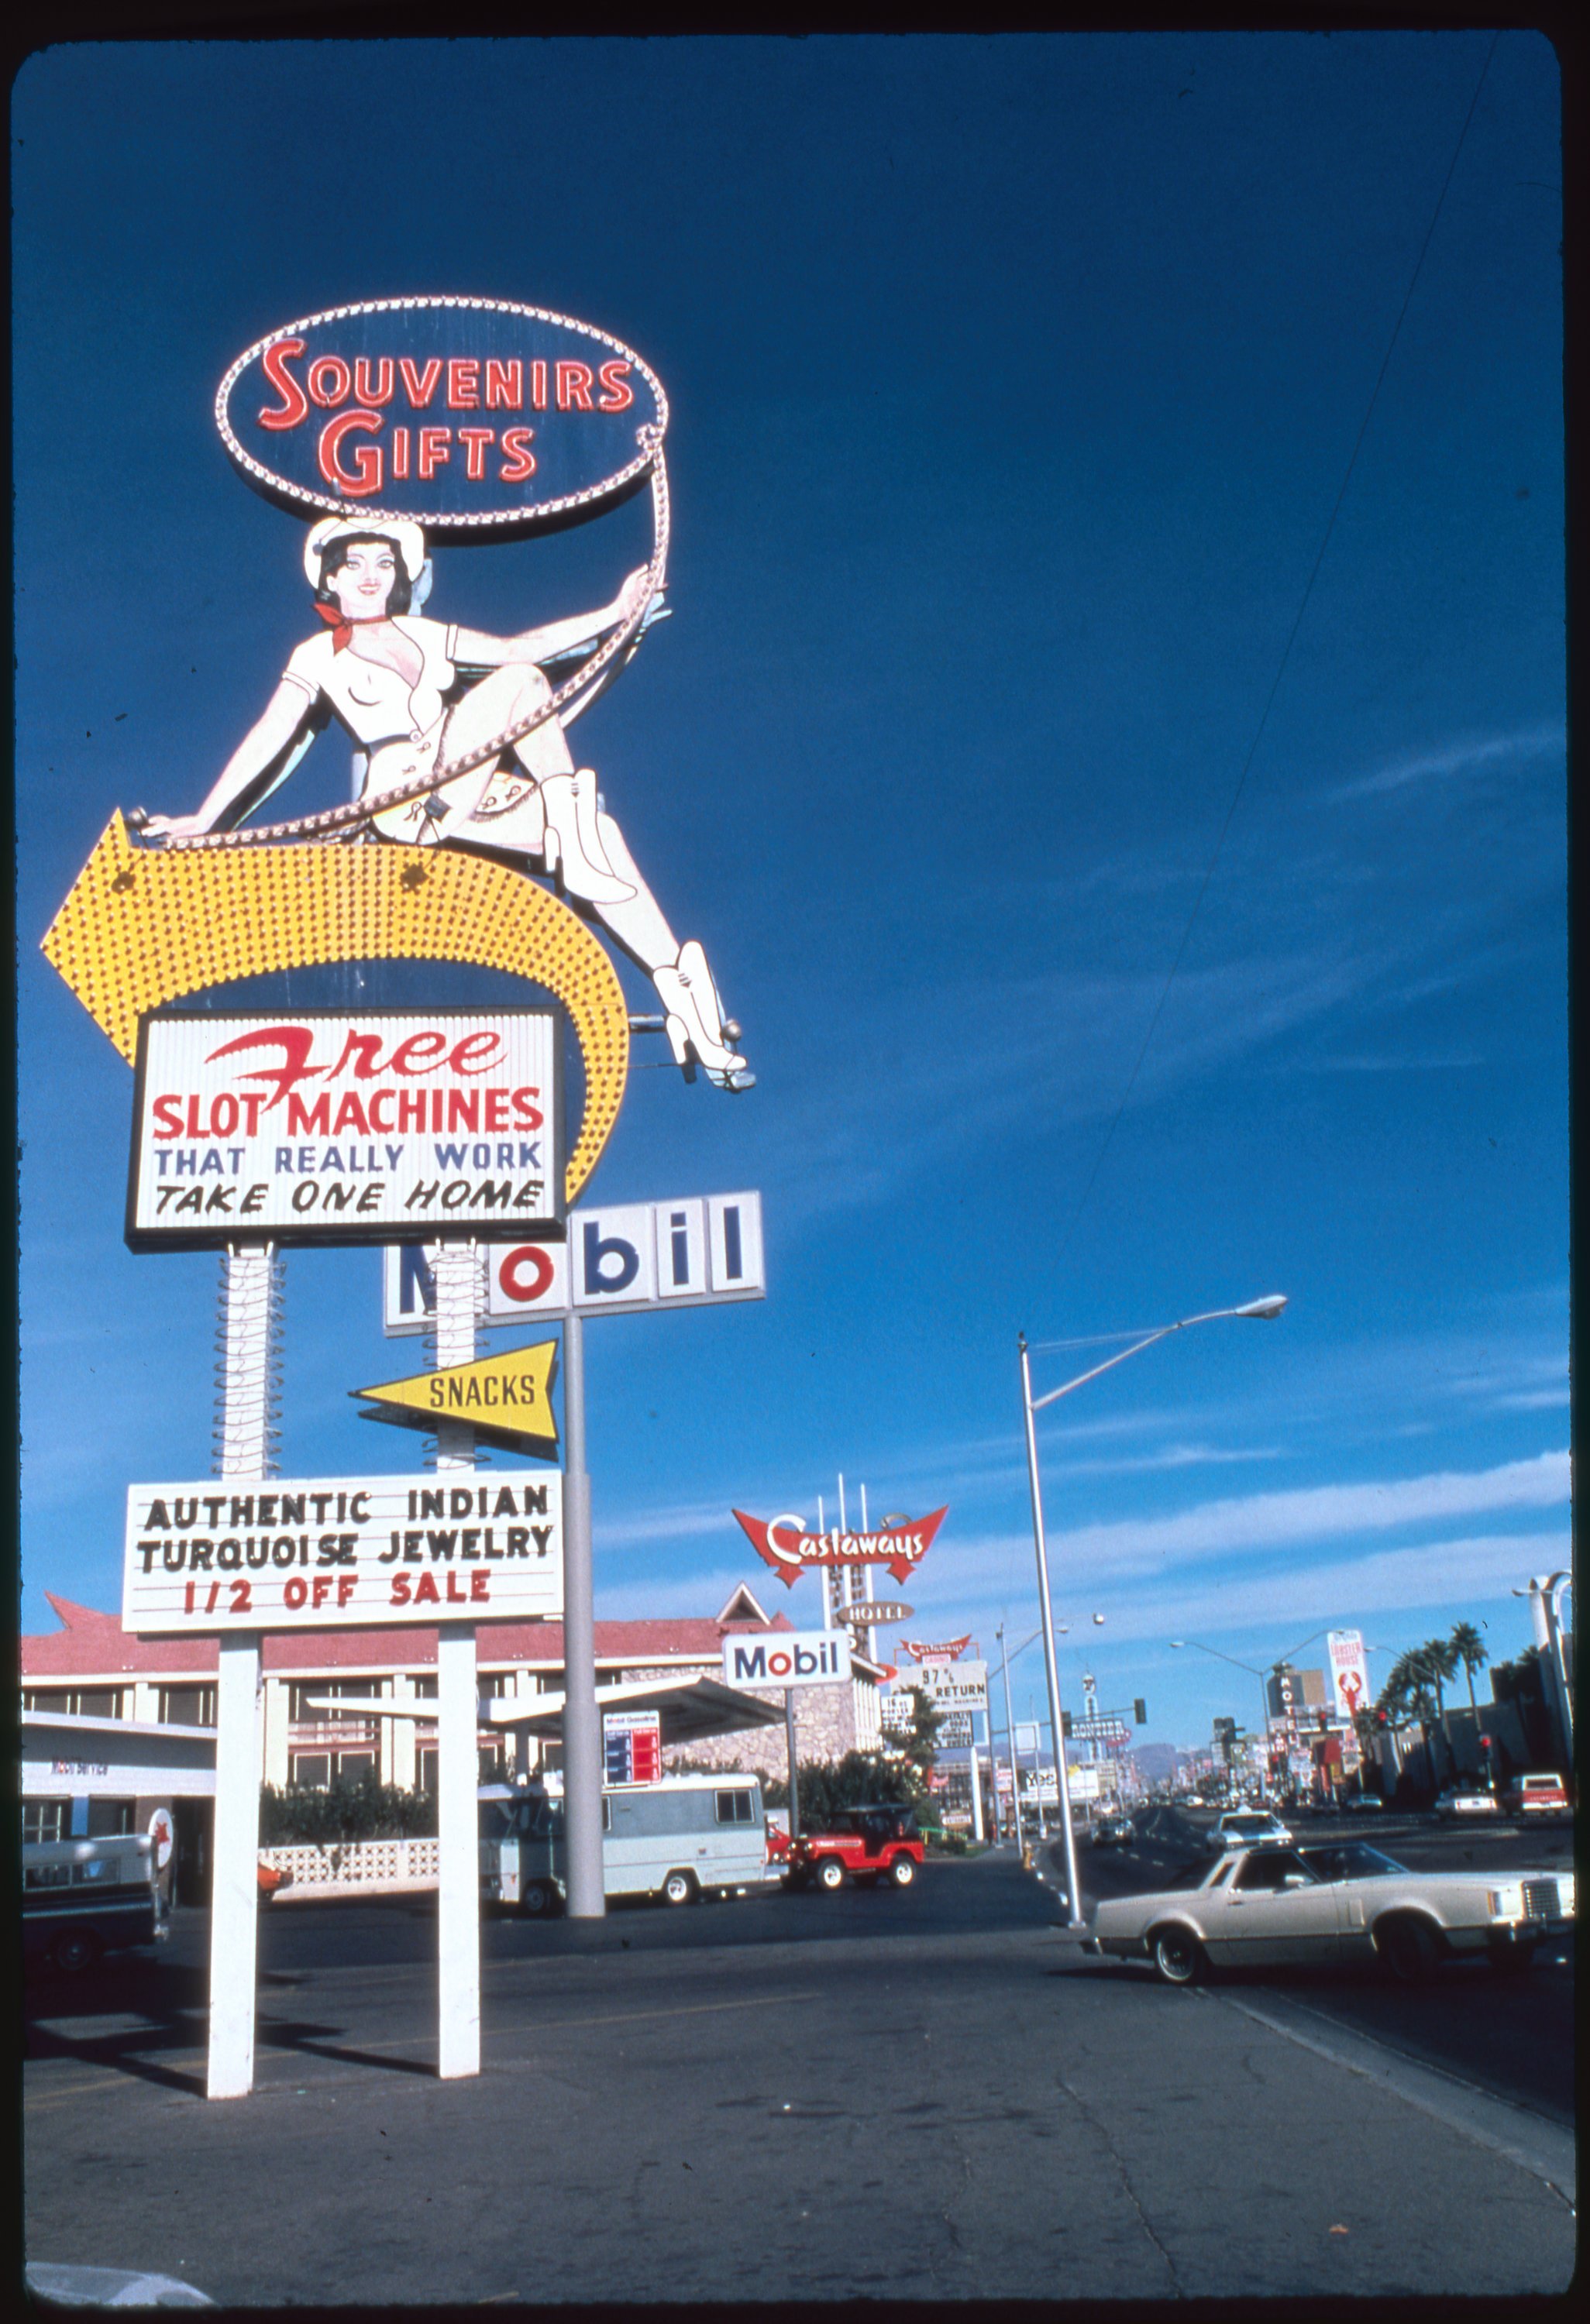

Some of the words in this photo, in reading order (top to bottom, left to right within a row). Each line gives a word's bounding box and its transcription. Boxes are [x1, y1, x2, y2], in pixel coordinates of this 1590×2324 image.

[257, 337, 634, 431] SOUVENIRS
[318, 409, 536, 497] GIFTS
[204, 1026, 508, 1115] Free
[152, 1092, 267, 1140] SLOT
[287, 1087, 544, 1137] MACHINES
[154, 1147, 245, 1176] THAT
[275, 1144, 404, 1174] REALLY
[435, 1141, 542, 1171] WORK
[155, 1183, 269, 1215] TAKE
[291, 1180, 386, 1212] ONE
[404, 1179, 544, 1211] HOME
[429, 1374, 535, 1408] SNACKS
[144, 1491, 372, 1530] AUTHENTIC
[408, 1484, 548, 1521] INDIAN
[136, 1532, 359, 1574] TURQUOISE
[378, 1525, 553, 1564] JEWELRY
[767, 1514, 923, 1564] Castaways
[283, 1574, 359, 1610] OFF
[389, 1569, 491, 1607] SALE
[849, 1606, 906, 1621] HOTEL
[734, 1642, 838, 1679] Mobil
[936, 1683, 985, 1697] RETURN
[1281, 1677, 1296, 1745] MOTEL
[1072, 1721, 1125, 1738] RONTIER
